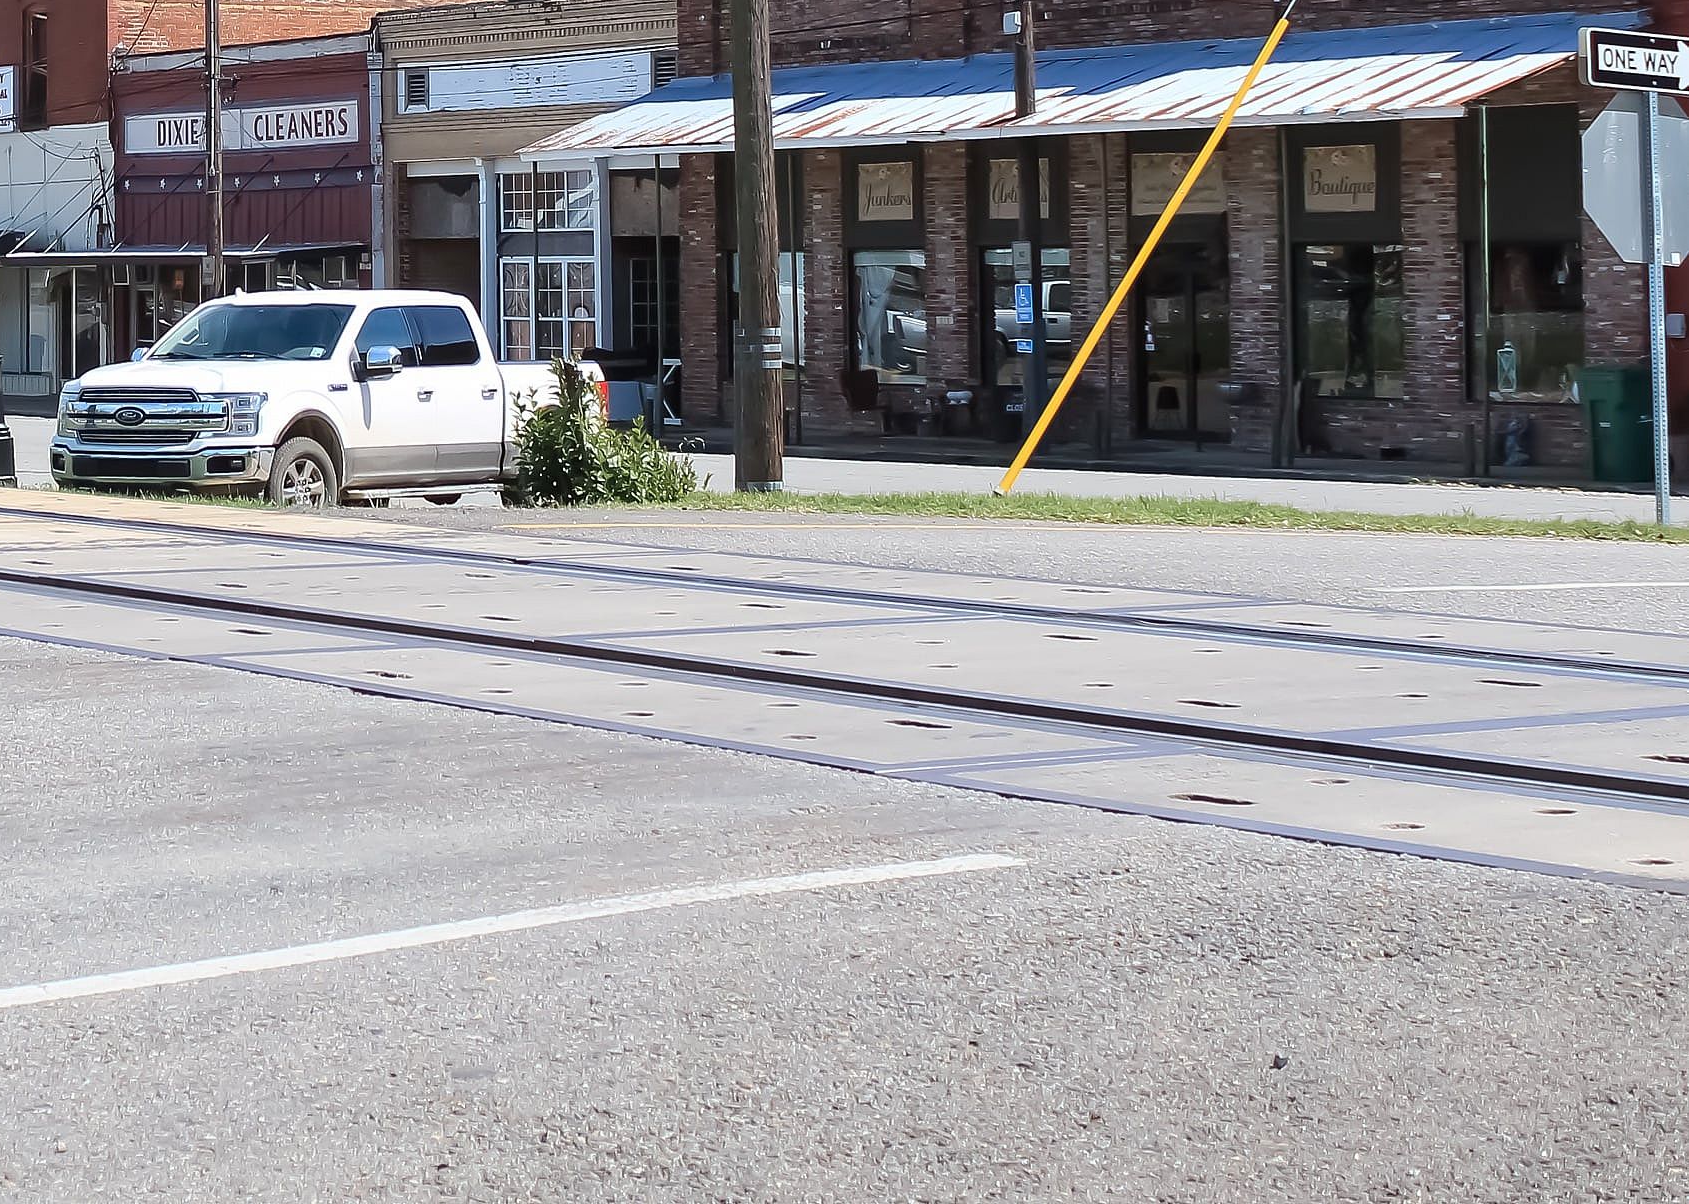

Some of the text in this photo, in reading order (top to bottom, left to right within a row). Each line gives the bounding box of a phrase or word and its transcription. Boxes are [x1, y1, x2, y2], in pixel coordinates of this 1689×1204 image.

[1603, 47, 1679, 74] ONE WAY
[157, 107, 349, 148] DIXIE CLEANERS
[863, 183, 912, 216] Junkers
[1309, 167, 1375, 205] Boutique
